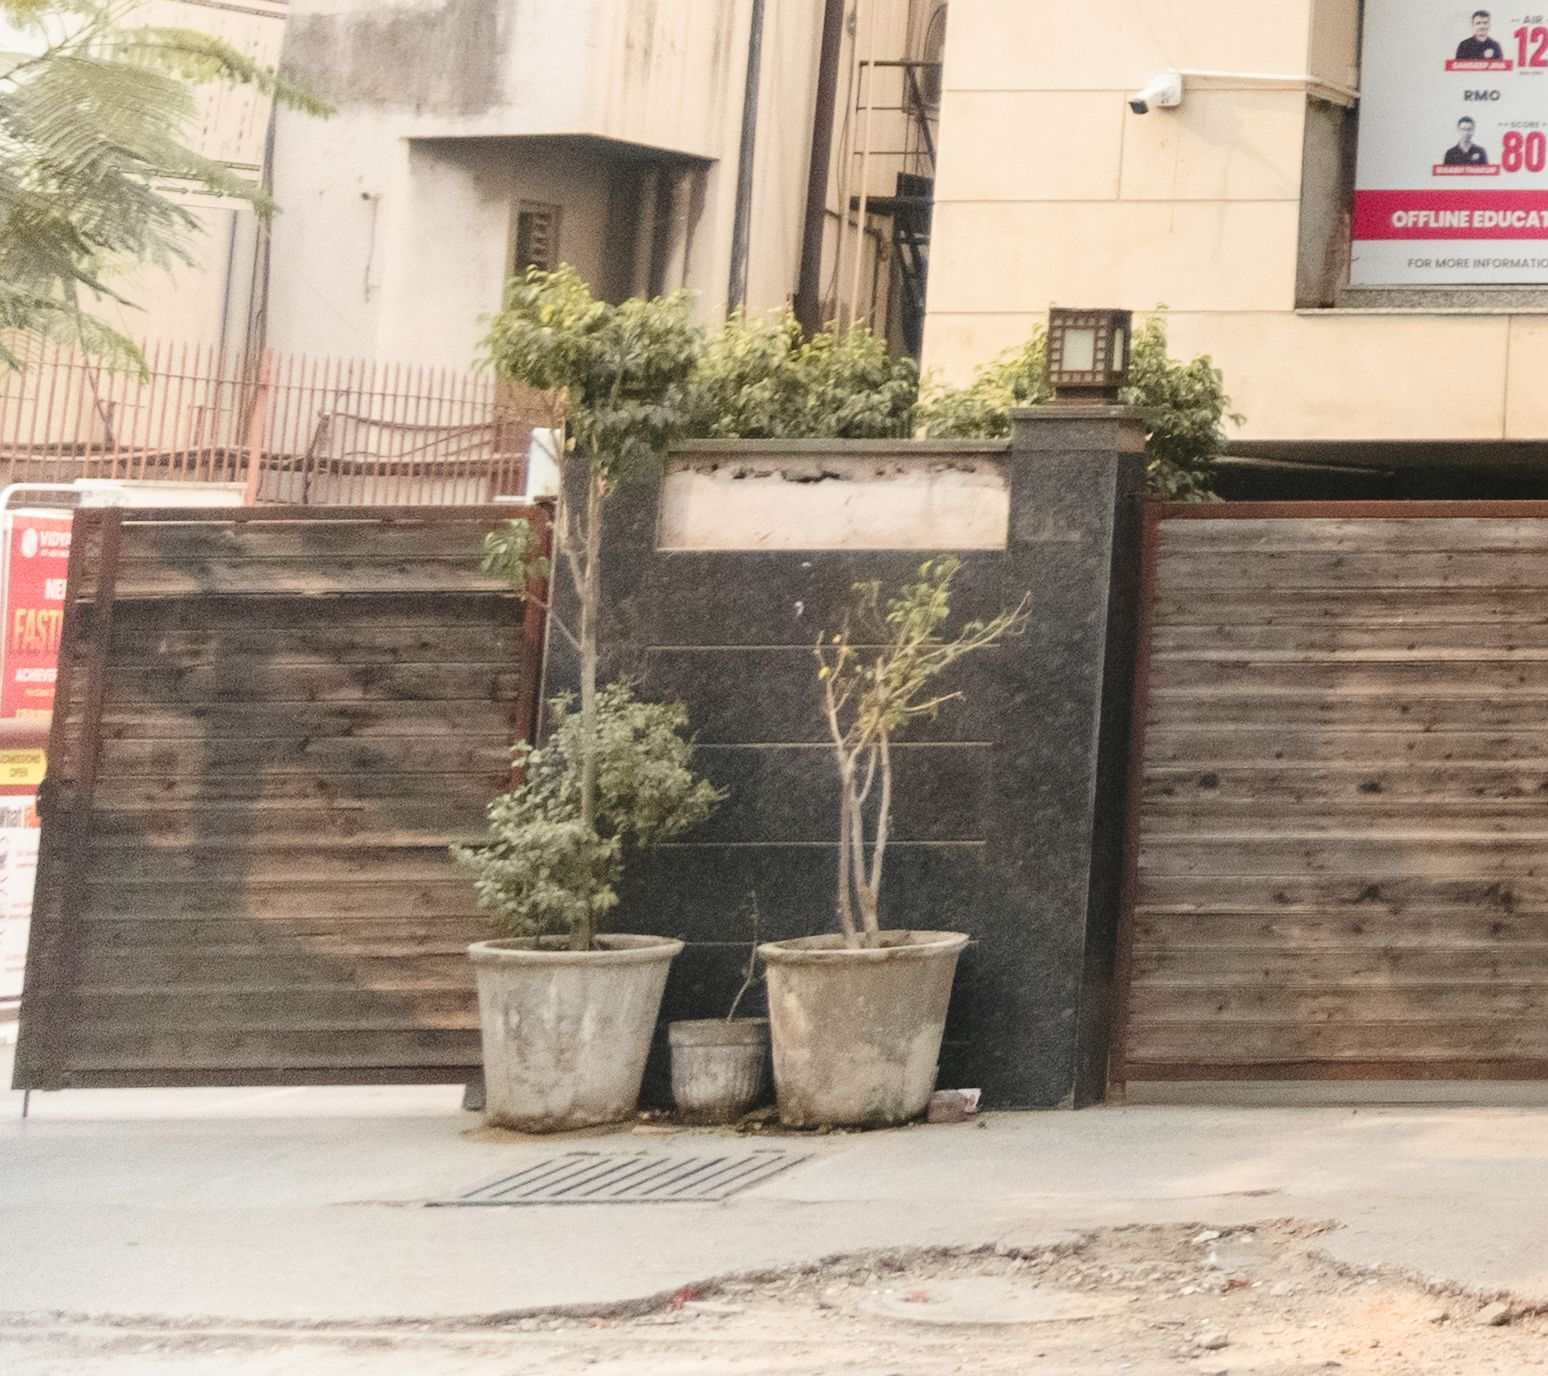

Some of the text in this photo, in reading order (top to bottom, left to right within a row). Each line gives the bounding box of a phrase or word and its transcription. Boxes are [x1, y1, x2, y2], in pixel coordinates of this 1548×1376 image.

[1523, 15, 1543, 24] AIR
[1464, 90, 1501, 102] RMO
[1510, 121, 1540, 129] SCORE
[1501, 131, 1547, 173] 80
[1392, 211, 1471, 229] OFFLINE
[1408, 258, 1432, 269] FOR
[1435, 258, 1470, 269] MORE
